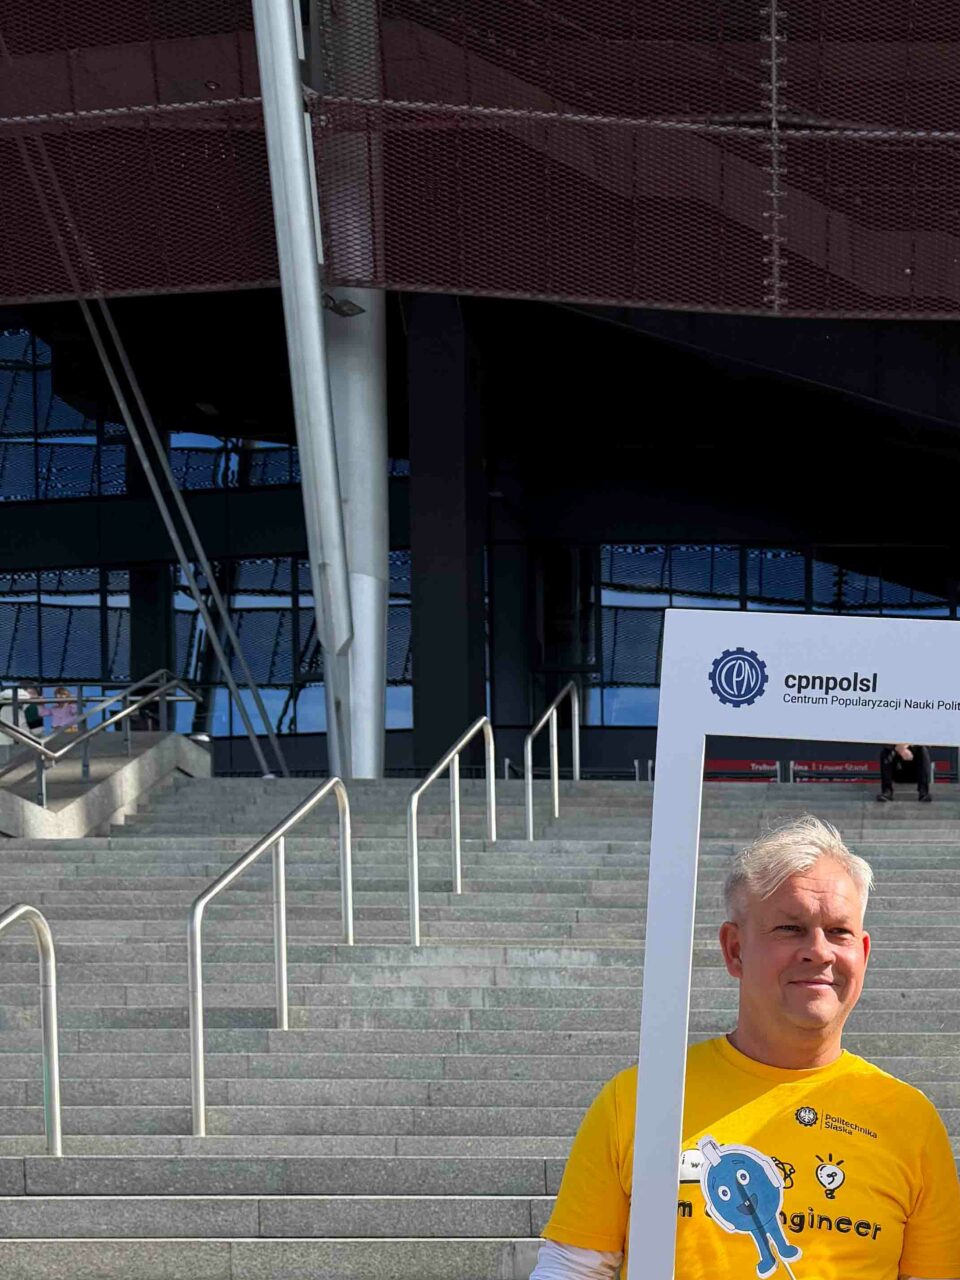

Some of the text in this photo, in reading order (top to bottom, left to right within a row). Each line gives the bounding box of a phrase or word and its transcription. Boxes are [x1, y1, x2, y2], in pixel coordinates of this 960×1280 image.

[783, 671, 878, 696] cpnpolsl
[782, 693, 829, 706] Centrum
[830, 695, 902, 711] Popularyzacji
[903, 698, 934, 711] Nauki
[825, 1113, 878, 1139] Politechnika
